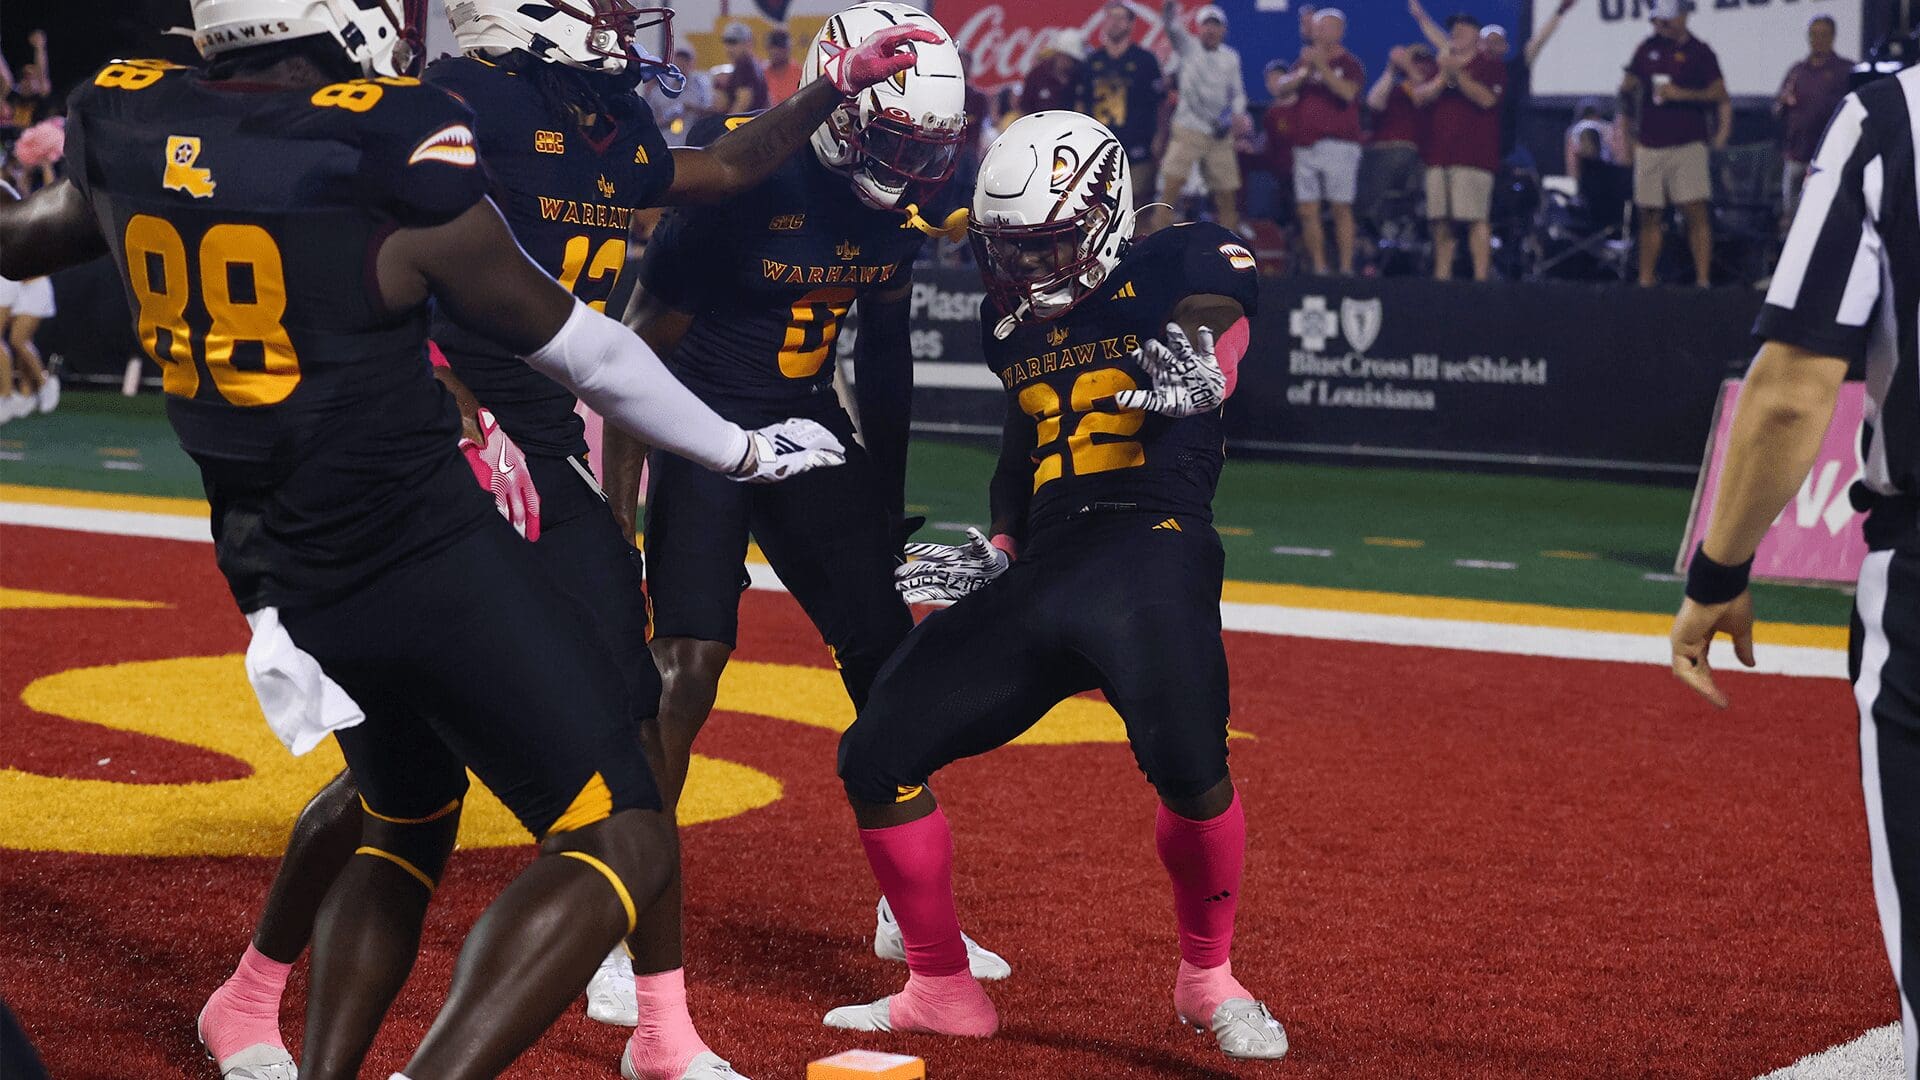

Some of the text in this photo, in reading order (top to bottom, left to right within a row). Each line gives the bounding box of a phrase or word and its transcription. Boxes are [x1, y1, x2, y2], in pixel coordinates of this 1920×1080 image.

[537, 196, 635, 230] WARHAW
[125, 213, 301, 407] 88
[762, 258, 899, 284] WARHAWK
[1017, 367, 1146, 496] 22
